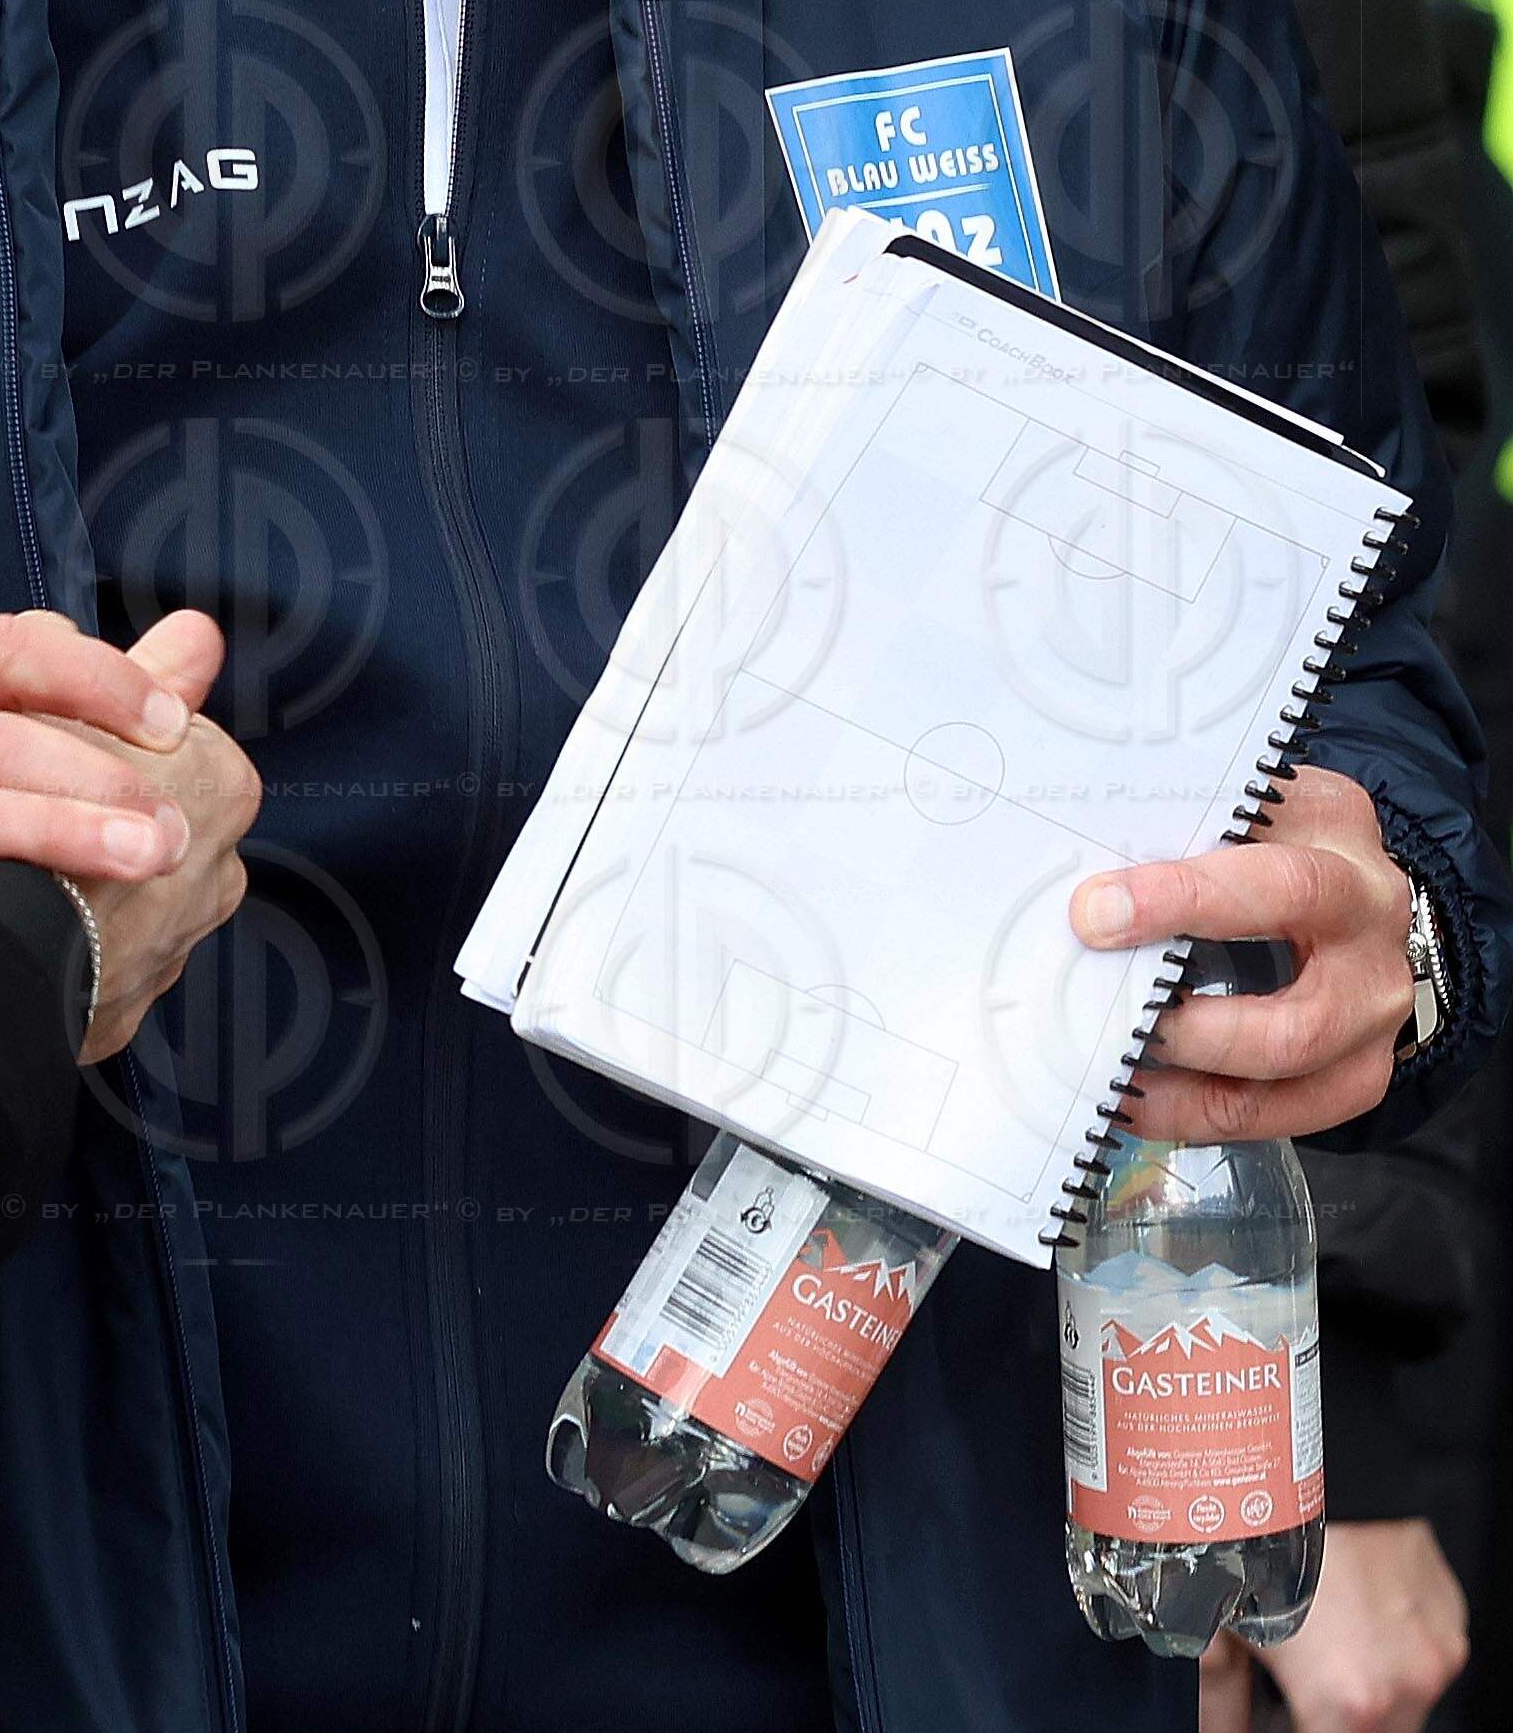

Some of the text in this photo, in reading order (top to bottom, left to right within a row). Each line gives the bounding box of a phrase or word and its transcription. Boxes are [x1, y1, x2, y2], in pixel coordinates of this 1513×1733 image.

[875, 105, 927, 152] FC
[826, 143, 1000, 197] BLAU WEISS
[1112, 1363, 1282, 1400] GASTEINER
